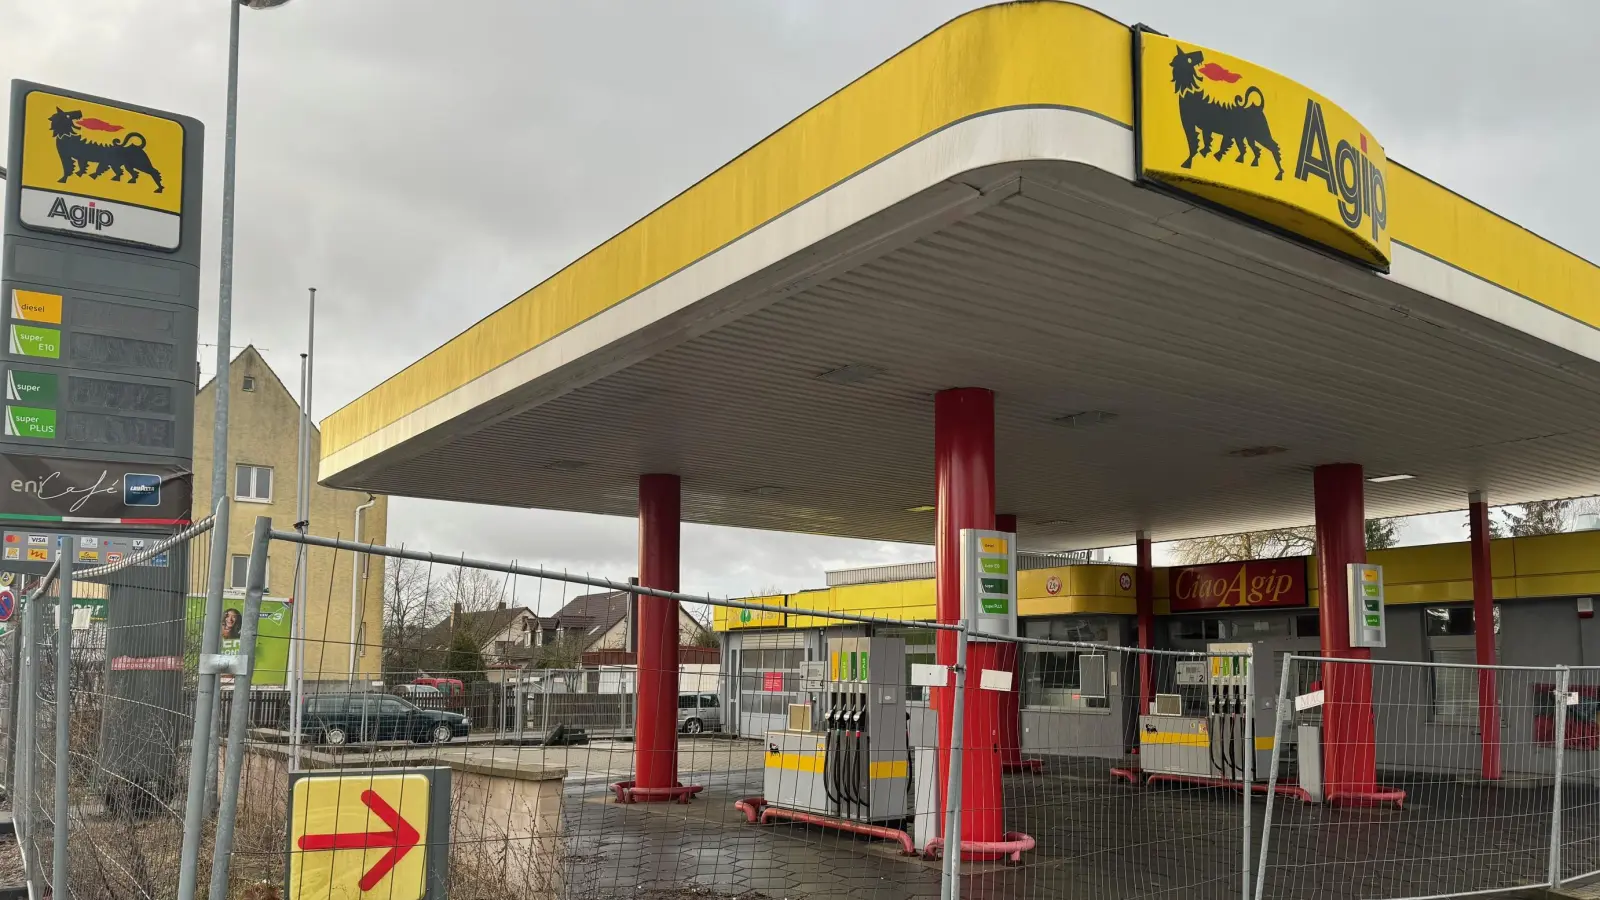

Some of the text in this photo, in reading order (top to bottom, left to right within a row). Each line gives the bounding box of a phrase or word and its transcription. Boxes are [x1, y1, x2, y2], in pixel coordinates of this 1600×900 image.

[1294, 98, 1387, 243] Agip
[47, 197, 114, 230] Agip
[21, 304, 45, 313] diesel
[20, 333, 43, 342] super
[38, 343, 55, 352] E10
[17, 383, 41, 392] super
[15, 414, 39, 423] super
[29, 424, 54, 433] PLUS
